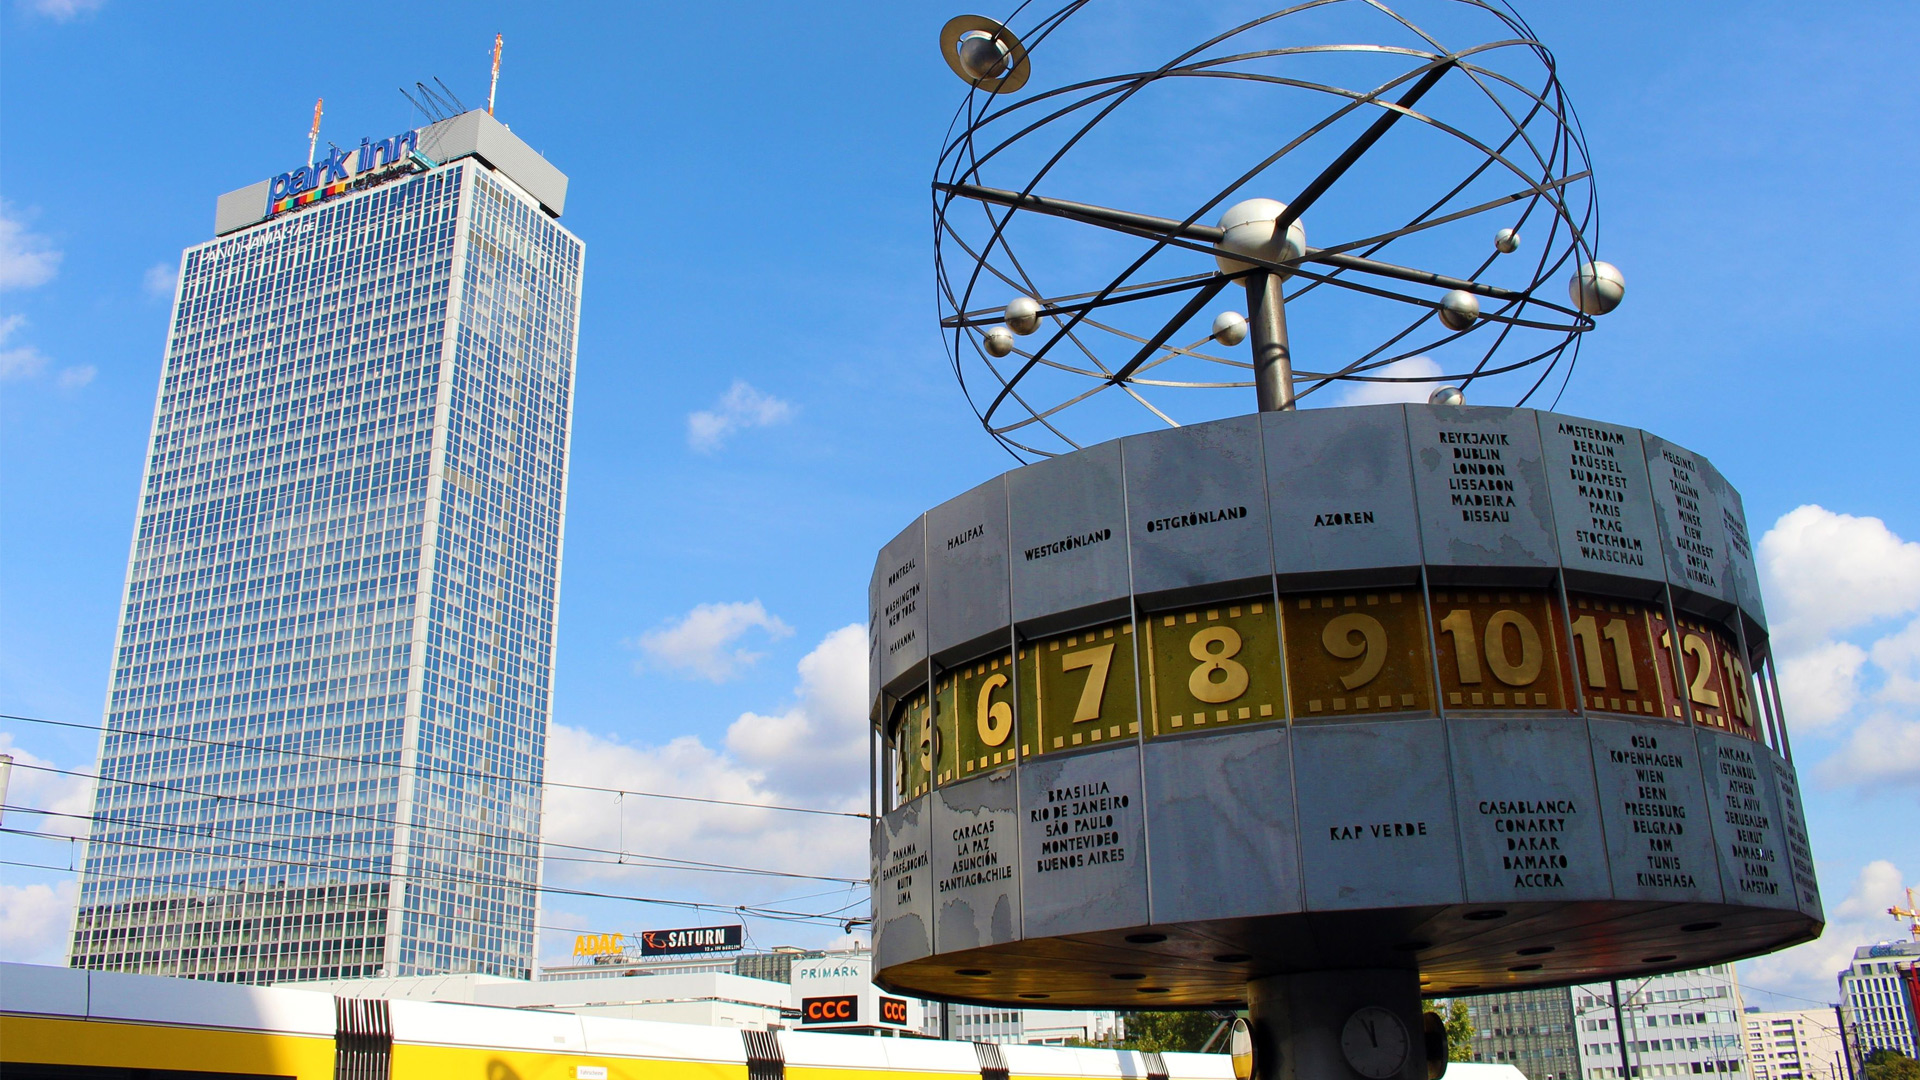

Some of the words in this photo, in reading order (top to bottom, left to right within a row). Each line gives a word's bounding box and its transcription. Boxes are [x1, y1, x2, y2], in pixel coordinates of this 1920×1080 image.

[265, 148, 352, 217] park
[356, 129, 418, 174] inn
[1439, 432, 1510, 446] REYKJAVIK
[1558, 423, 1625, 445] AMSTERDAM
[1454, 447, 1500, 460] DUBLIN
[1573, 440, 1614, 458] BERLIN
[1453, 463, 1505, 476] LONDON
[1571, 454, 1622, 473] BRÜSSEL
[1662, 450, 1695, 473] HELSINKI
[1570, 468, 1627, 489] BUDAPEST
[1673, 467, 1691, 484] RIGA
[1449, 478, 1514, 492] LISSABON
[1579, 485, 1624, 503] MADRID
[1669, 479, 1699, 500] TALLINN
[1452, 494, 1516, 508] MADEIRA
[1589, 502, 1621, 517] PARIS
[1675, 494, 1699, 513] WILNA
[1147, 506, 1247, 533] OSTGRÖNLAND
[1314, 511, 1374, 527] AZOREN
[1462, 510, 1510, 523] BISSAU
[1592, 517, 1622, 532] PRAG
[1678, 510, 1702, 528] MINSK
[947, 524, 984, 550] HALIFAX
[1576, 530, 1643, 551] STOCKHOLM
[1683, 524, 1701, 541] KIEW
[1025, 528, 1111, 561] WESTGRÖNLAND
[1677, 536, 1714, 559] BUKAREST
[1581, 546, 1644, 566] WARSCHAU
[1687, 554, 1710, 572] SOFIA
[888, 559, 916, 587] MONTREAL
[1686, 567, 1717, 588] NIKOSIA
[885, 582, 920, 617] WASHINGTON
[889, 611, 900, 628] NEW
[902, 601, 916, 618] YORK
[890, 629, 915, 655] HAVANNA
[1322, 612, 1388, 690] 9
[1440, 609, 1543, 686] 10
[1572, 615, 1639, 691] 11
[1188, 626, 1249, 703] 8
[1062, 643, 1115, 723] 7
[976, 673, 1013, 747] 6
[1631, 735, 1657, 749] OSLO
[1611, 750, 1683, 768] KOPENHAGEN
[1718, 746, 1753, 764] ANKARA
[1636, 769, 1664, 783] WIEN
[1720, 762, 1757, 780] ISTANBUL
[1048, 782, 1110, 803] BRASILIA
[1639, 786, 1666, 800] BERN
[1729, 780, 1755, 795] ATHEN
[1031, 807, 1049, 823] RIO
[1053, 804, 1068, 819] DE
[1073, 795, 1129, 816] JANEIRO
[1479, 800, 1577, 815] CASABLANCA
[1625, 802, 1686, 819] PRESSBURG
[1727, 795, 1741, 809] TEL
[1744, 799, 1760, 812] AVIV
[1075, 815, 1113, 833] PAULO
[1495, 819, 1565, 833] CONAKRY
[1633, 820, 1683, 836] BELGRAD
[1725, 811, 1769, 830] JERUSALEM
[953, 820, 995, 841] CARACAS
[1330, 826, 1363, 840] KAP
[1370, 822, 1427, 838] VERDE
[1737, 829, 1763, 844] BEIRUT
[958, 844, 969, 857] LA
[973, 838, 989, 853] PAZ
[1042, 831, 1119, 855] MONTEVIDEO
[1508, 837, 1560, 851] DAKAR
[1650, 838, 1673, 851] ROM
[893, 843, 916, 862] PANAMA
[1037, 854, 1083, 873] BUENOS
[1088, 848, 1125, 867] AIRES
[952, 850, 998, 874] ASUNCIÓN
[1503, 855, 1567, 870] BAMAKO
[1647, 856, 1681, 870] TUNIS
[1745, 863, 1768, 878] KAIRO
[897, 875, 912, 891] QUITO
[1514, 873, 1564, 888] ACCRA
[1637, 873, 1696, 888] KINSHASA
[1740, 879, 1779, 896] KAPSTADT
[898, 891, 911, 905] LIMA
[573, 932, 624, 956] ADAC
[668, 928, 725, 948] SATURN
[801, 965, 859, 980] PRIMARK
[808, 1000, 850, 1019] CCC
[884, 1002, 906, 1021] CCC
